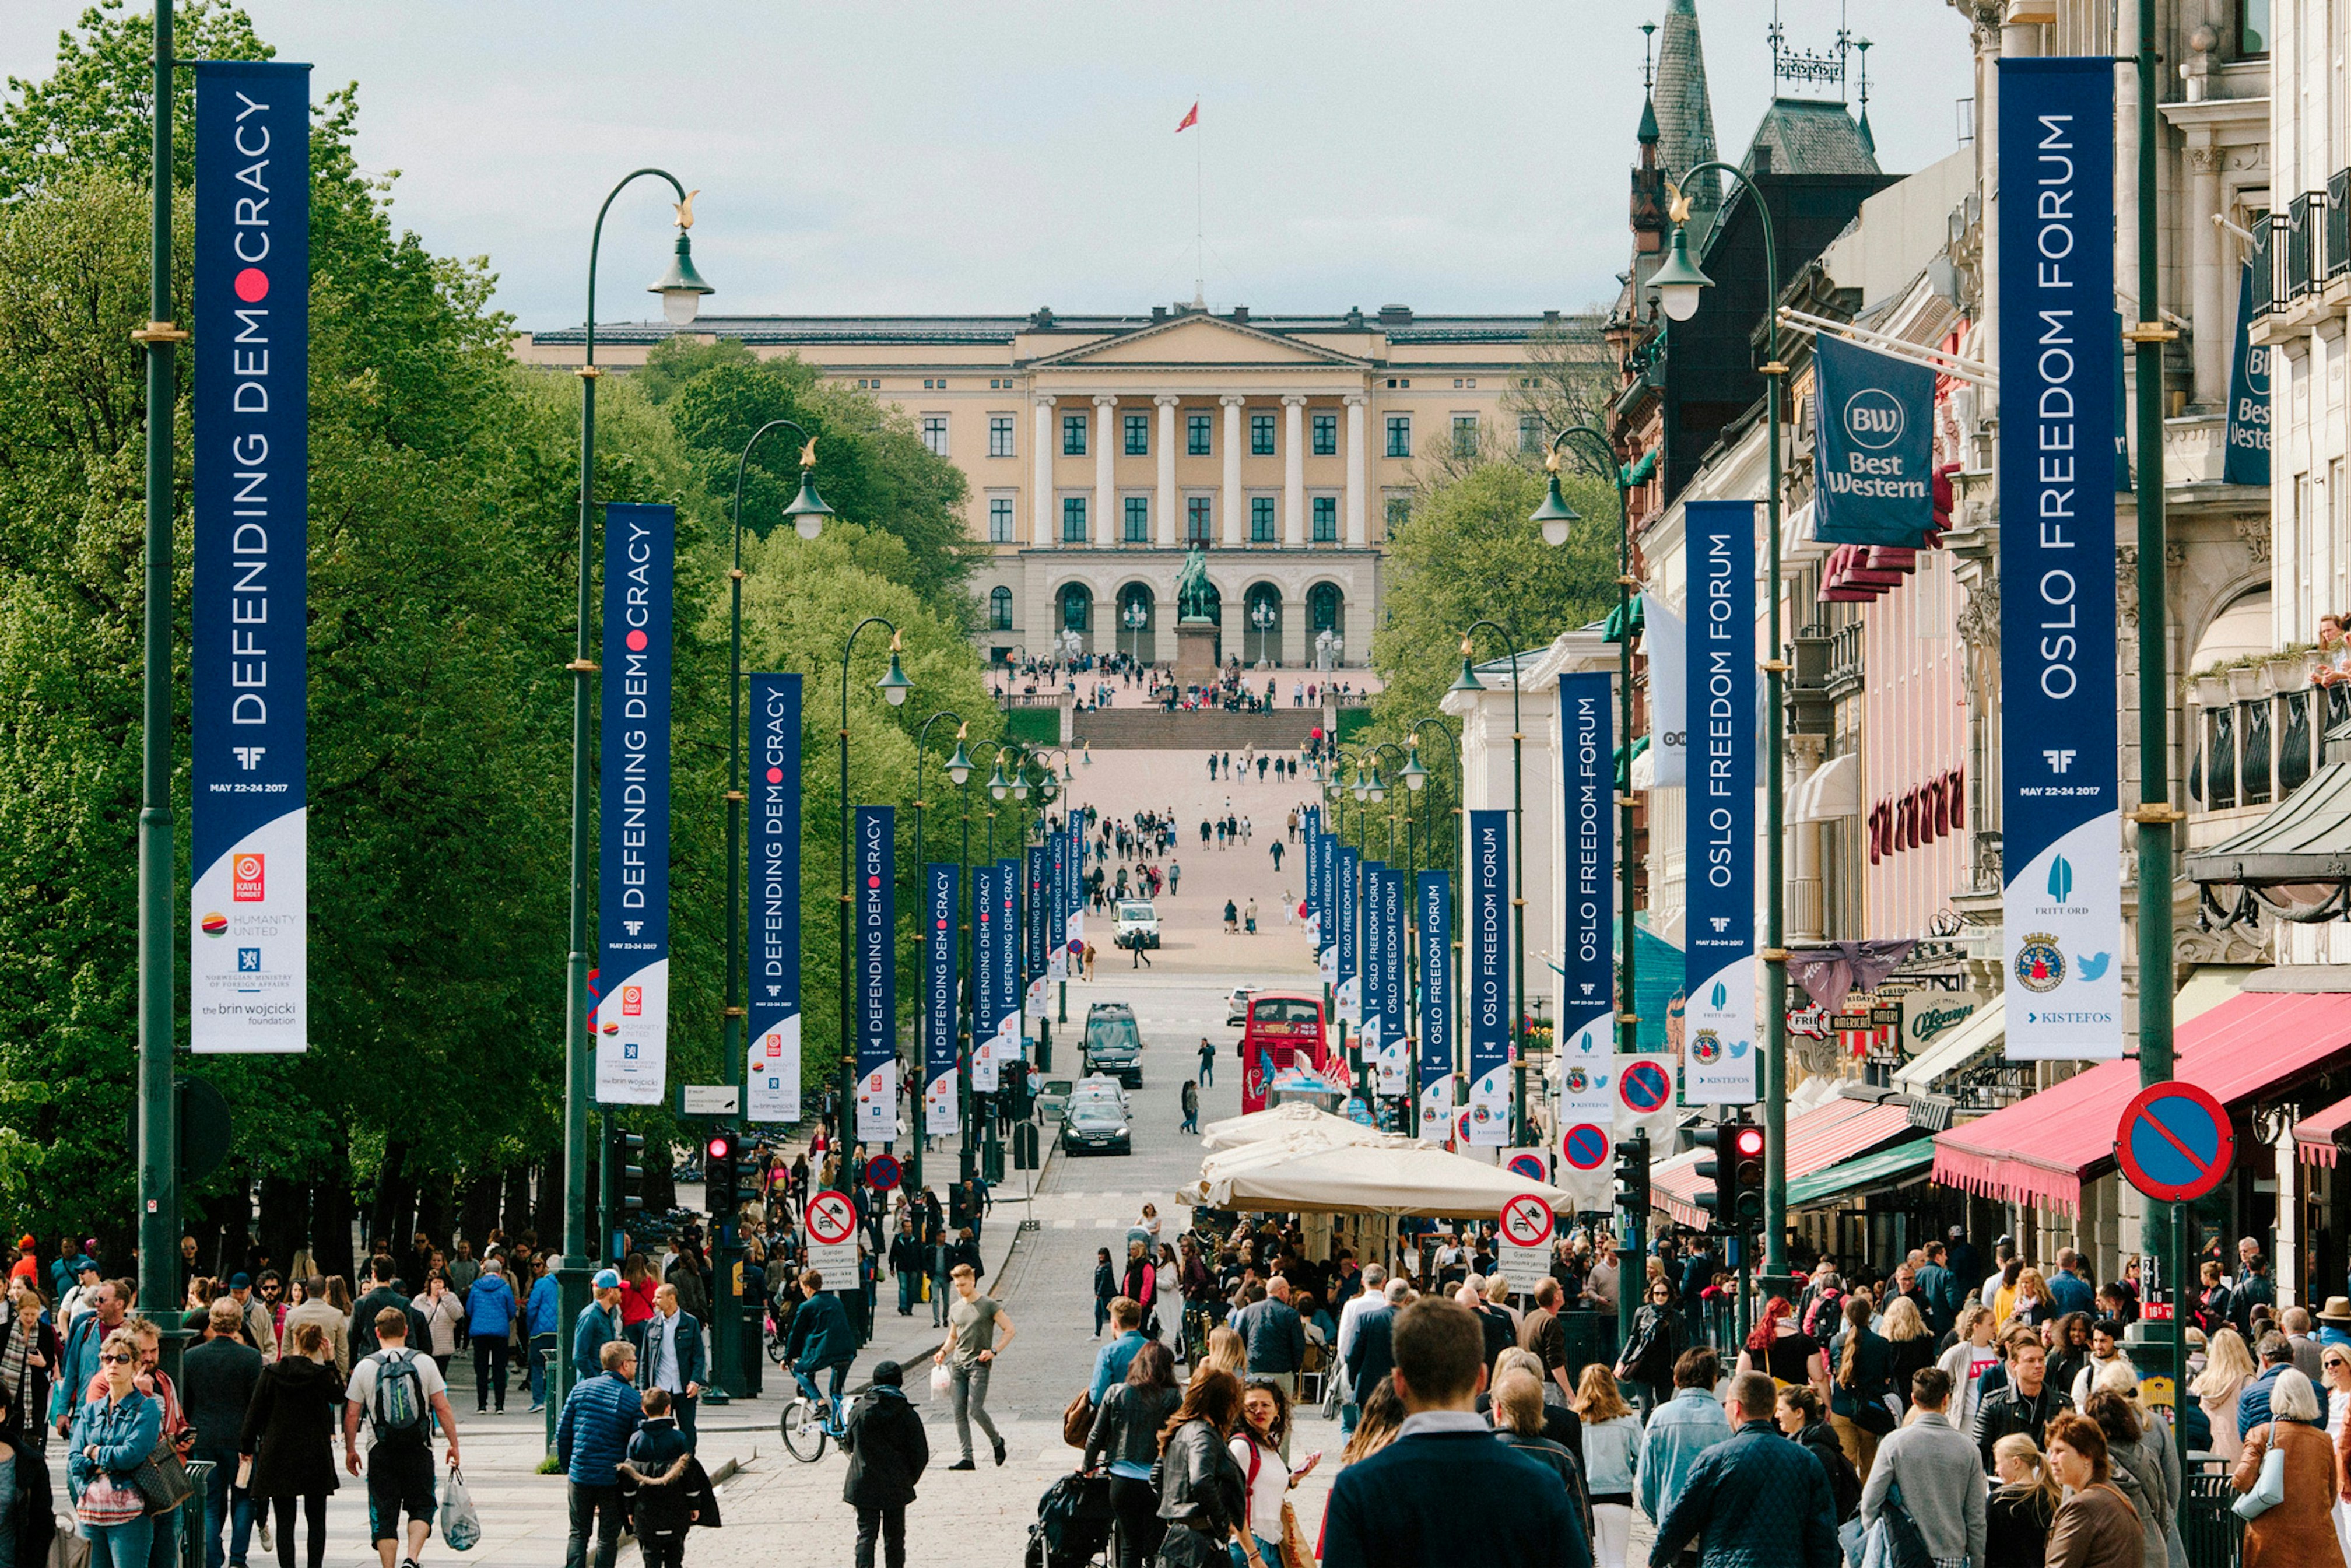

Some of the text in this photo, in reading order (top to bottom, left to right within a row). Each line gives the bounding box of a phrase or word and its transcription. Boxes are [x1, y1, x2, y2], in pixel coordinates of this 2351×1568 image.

[2038, 115, 2076, 699] OSLO FREEDOM FORUM
[1849, 452, 1902, 475] Best
[1828, 472, 1925, 498] Western
[233, 434, 268, 724] DEFENDING
[1709, 535, 1731, 887] OSLO FREEDOM FORUM
[210, 784, 289, 792] MAY 22-24 2017
[2020, 787, 2100, 796] MAY 22-24 2017
[624, 731, 646, 907] DEFENDING
[1578, 699, 1596, 961] OSLO FREEDOM FORUM
[237, 882, 261, 890] KAVLI
[234, 915, 296, 924] HUMANITY
[766, 843, 782, 975] DEFENDING
[233, 927, 278, 936] UNITED
[1483, 829, 1497, 1026] OSLO FREEDOM FORUM
[1387, 882, 1397, 1013] OSLO FREEDOM FORUM
[1370, 963, 1378, 990] OSLO
[1429, 886, 1442, 1044] OSLO FREEDOM FORUM
[869, 932, 882, 1031] DEFENDING
[981, 951, 989, 1017] DEFENDING
[219, 1003, 242, 1013] brin
[245, 1002, 296, 1016] wojcicki
[936, 964, 946, 1045] DEFENDING
[2042, 1012, 2112, 1023] KISTEFOS
[248, 1016, 296, 1025] foundation
[628, 1078, 658, 1087] wojcicki
[2152, 1291, 2163, 1303] 16
